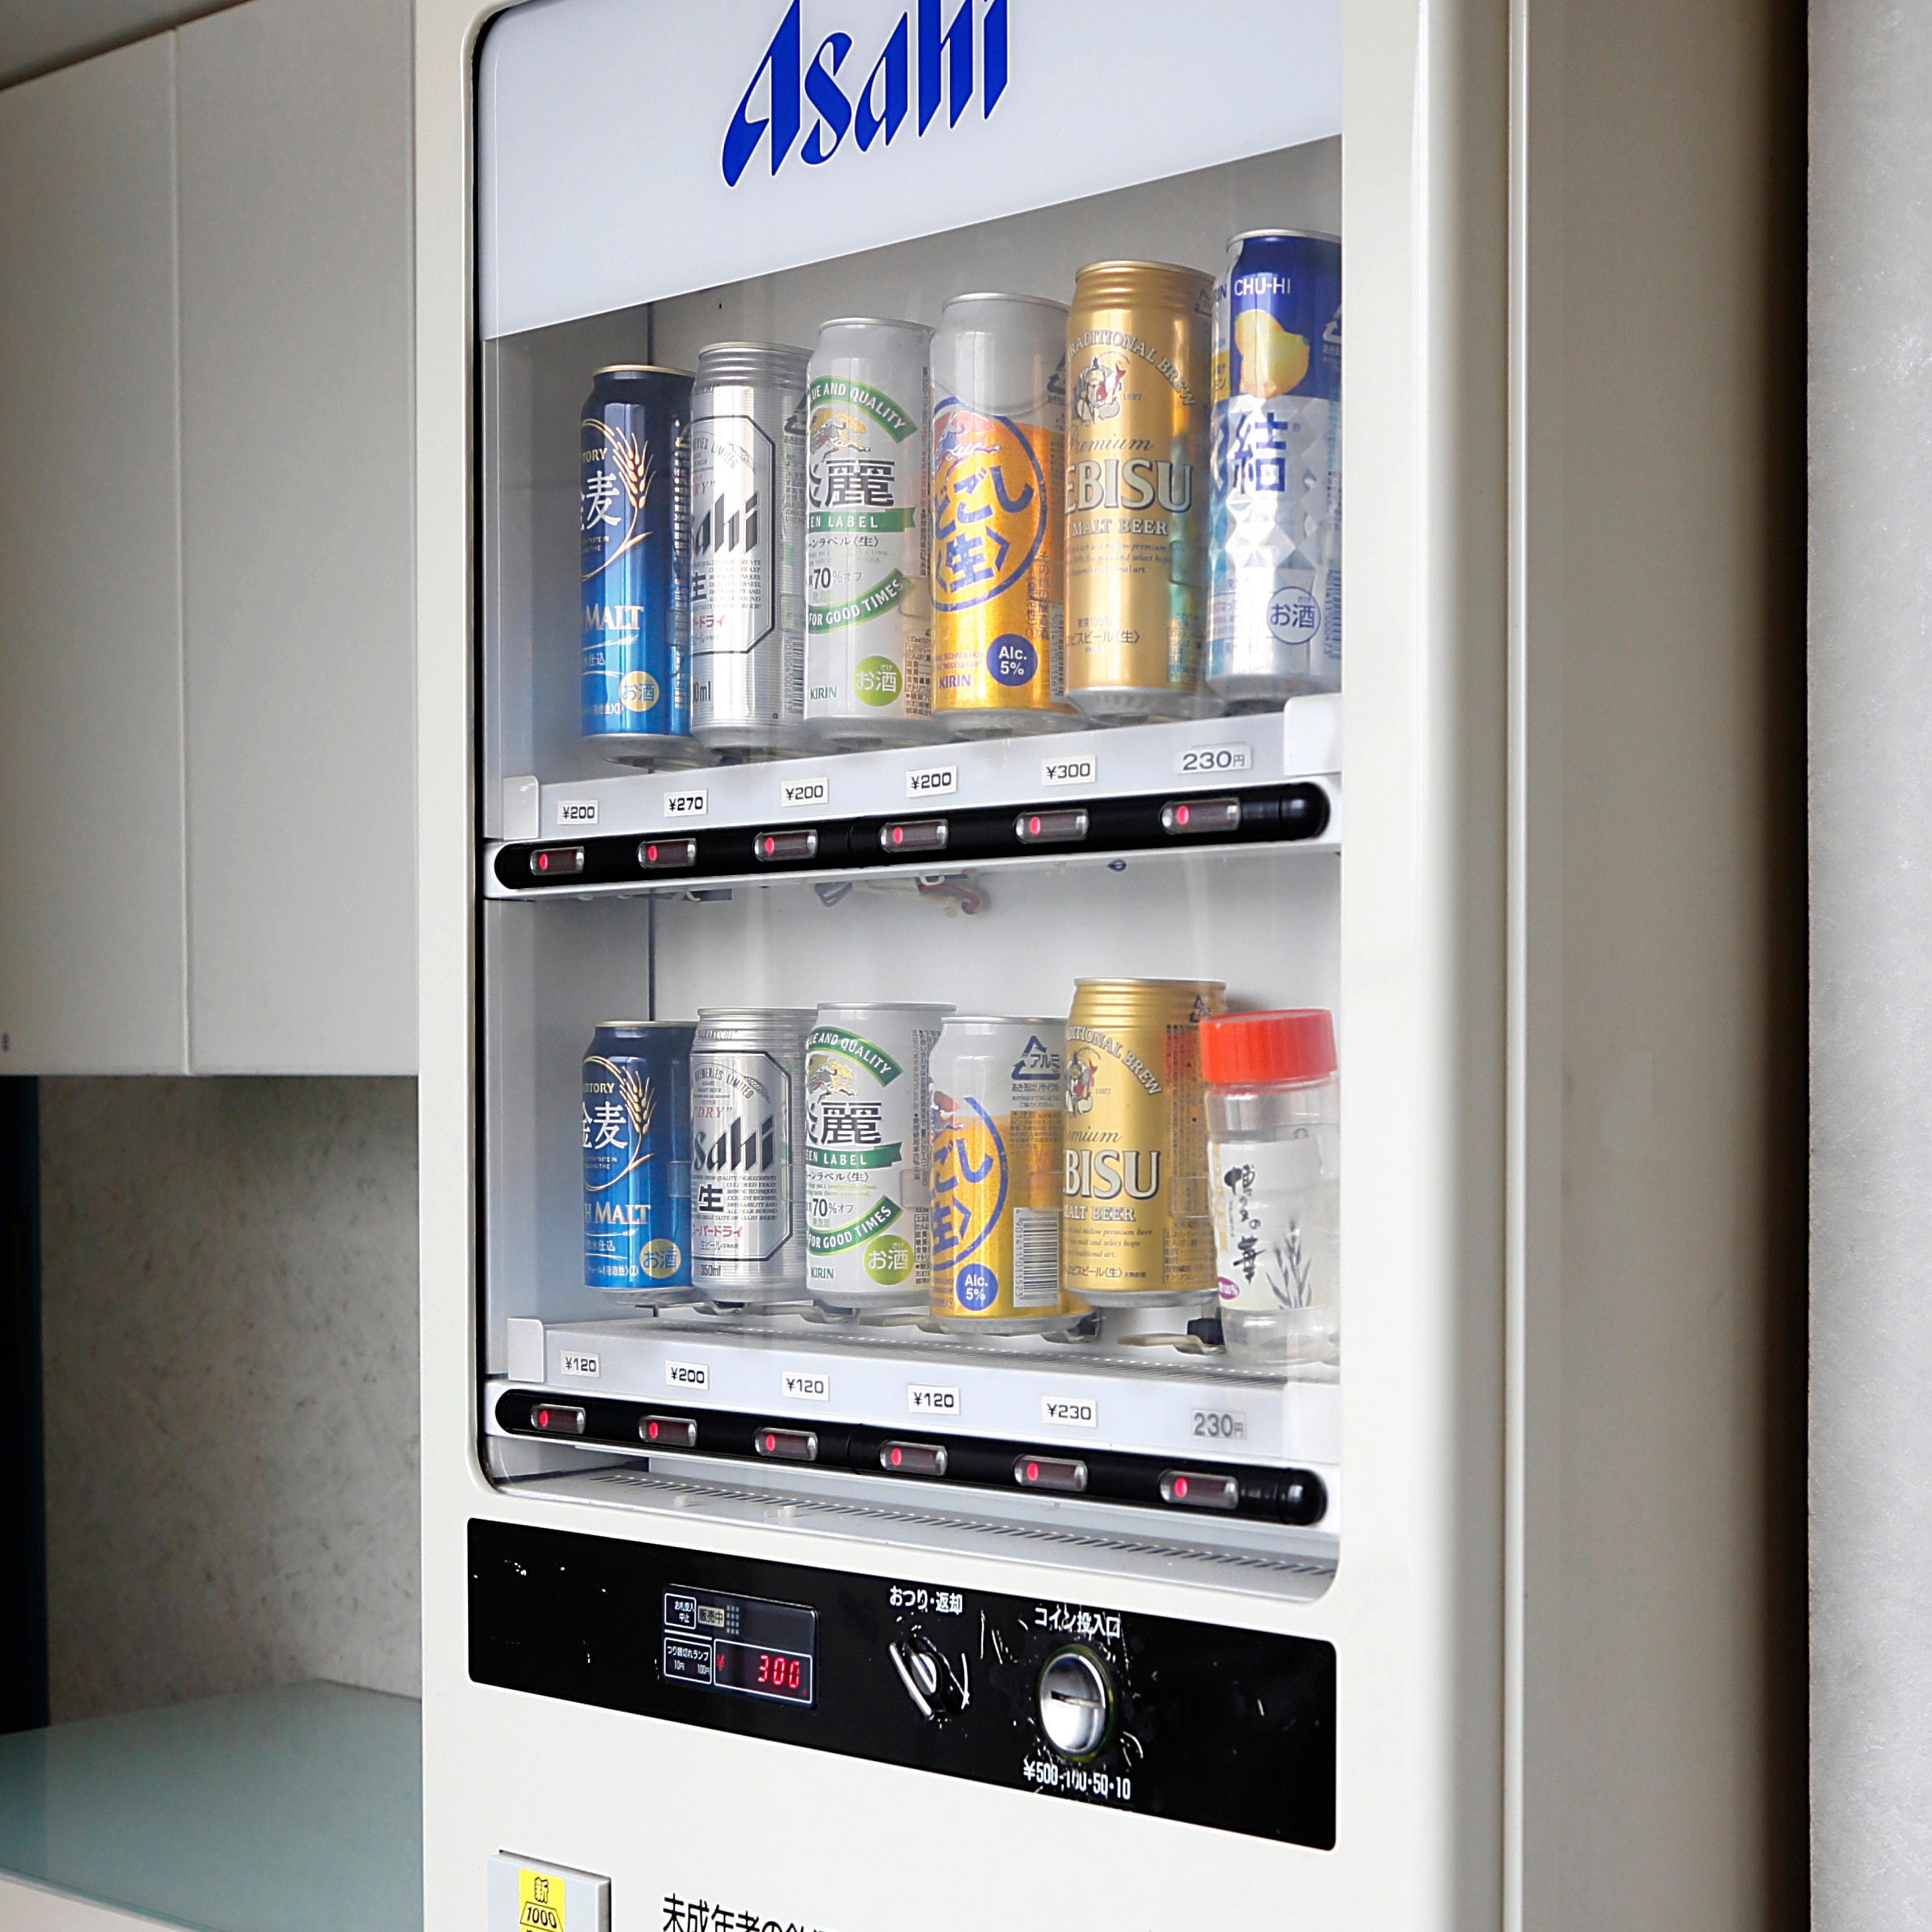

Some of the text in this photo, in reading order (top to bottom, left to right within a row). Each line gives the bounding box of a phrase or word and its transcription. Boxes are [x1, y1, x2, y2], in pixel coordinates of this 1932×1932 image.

[722, 0, 1008, 188] Asahi
[1234, 277, 1291, 296] CHU-HI
[1157, 357, 1196, 406] BREW
[822, 382, 846, 397] AND
[849, 389, 907, 431] QUALITY
[582, 447, 608, 464] TORY
[692, 480, 715, 497] RY”
[1065, 458, 1193, 513] EBISU
[581, 470, 622, 533] 麦
[692, 491, 758, 556] ahi
[827, 515, 879, 529] LABEL
[1073, 517, 1169, 537] MALT BEER
[809, 579, 904, 626] FOR GOOD TIMES
[586, 603, 644, 630] MALT
[1269, 603, 1316, 629] お酒
[998, 645, 1028, 659] Alc.
[784, 639, 792, 711] 901004 006813
[1000, 662, 1025, 676] 5%
[693, 681, 711, 702] 0ml
[856, 670, 897, 693] お酒
[939, 674, 971, 690] KIRIN
[621, 683, 655, 702] お酒
[810, 686, 838, 701] KIRIN
[1046, 762, 1091, 780] ¥300
[1182, 751, 1245, 771] 230円
[910, 771, 952, 790] ¥200
[785, 785, 824, 801] ¥200
[562, 805, 596, 819] ¥200
[668, 797, 703, 812] ¥270
[819, 1033, 891, 1075] AND QUALITY
[1030, 1053, 1061, 1073] アルミ
[1123, 1050, 1162, 1095] BREW
[725, 1073, 755, 1099] LIMITED
[823, 1153, 867, 1166] LABEL
[698, 1183, 724, 1212] 生
[594, 1201, 651, 1225] MALT
[1092, 1207, 1136, 1222] BEER
[808, 1205, 892, 1249] FOR GOOD TIMES
[1015, 1221, 1023, 1259] 901411
[643, 1250, 678, 1269] お酒
[868, 1248, 910, 1270] お酒
[700, 1264, 721, 1277] 350ml
[810, 1266, 835, 1279] KIRIN
[965, 1274, 989, 1287] Alc.
[1015, 1261, 1023, 1298] 011523
[965, 1288, 986, 1301] 5%
[564, 1357, 597, 1372] ¥120
[670, 1366, 706, 1384] ¥200
[786, 1377, 824, 1394] ¥120
[912, 1391, 955, 1408] ¥120
[1047, 1403, 1092, 1421] ¥230
[1193, 1413, 1244, 1438] 230円
[889, 1585, 963, 1614] おつり・返却
[678, 1613, 690, 1623] 中止
[1034, 1606, 1121, 1640] コイン投入口
[674, 1660, 685, 1671] 10円
[758, 1653, 801, 1689] 300
[533, 1876, 549, 1904] 新
[527, 1906, 557, 1929] 1000
